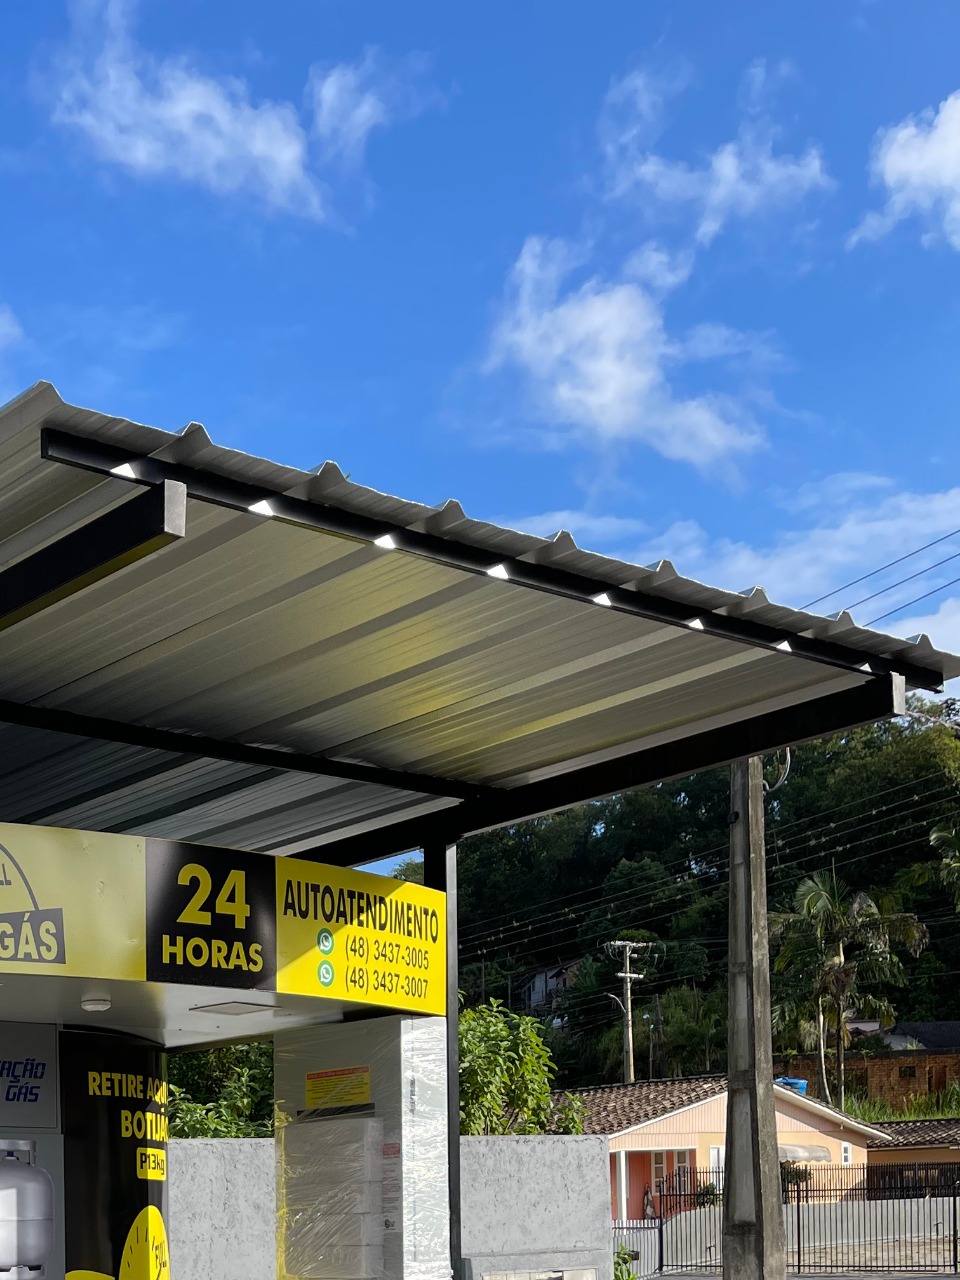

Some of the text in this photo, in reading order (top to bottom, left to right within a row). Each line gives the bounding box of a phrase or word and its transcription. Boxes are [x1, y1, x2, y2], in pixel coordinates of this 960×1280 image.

[176, 863, 251, 929] 24
[283, 879, 439, 944] AUTOATENDIMENTO
[162, 934, 263, 973] HORAS
[345, 933, 430, 971] (48) 3437-3005
[345, 965, 429, 998] (48) 3437-3007
[5, 1082, 41, 1102] GÁS
[88, 1071, 169, 1105] RETIRE AQUI
[140, 1153, 165, 1176] P13kg
